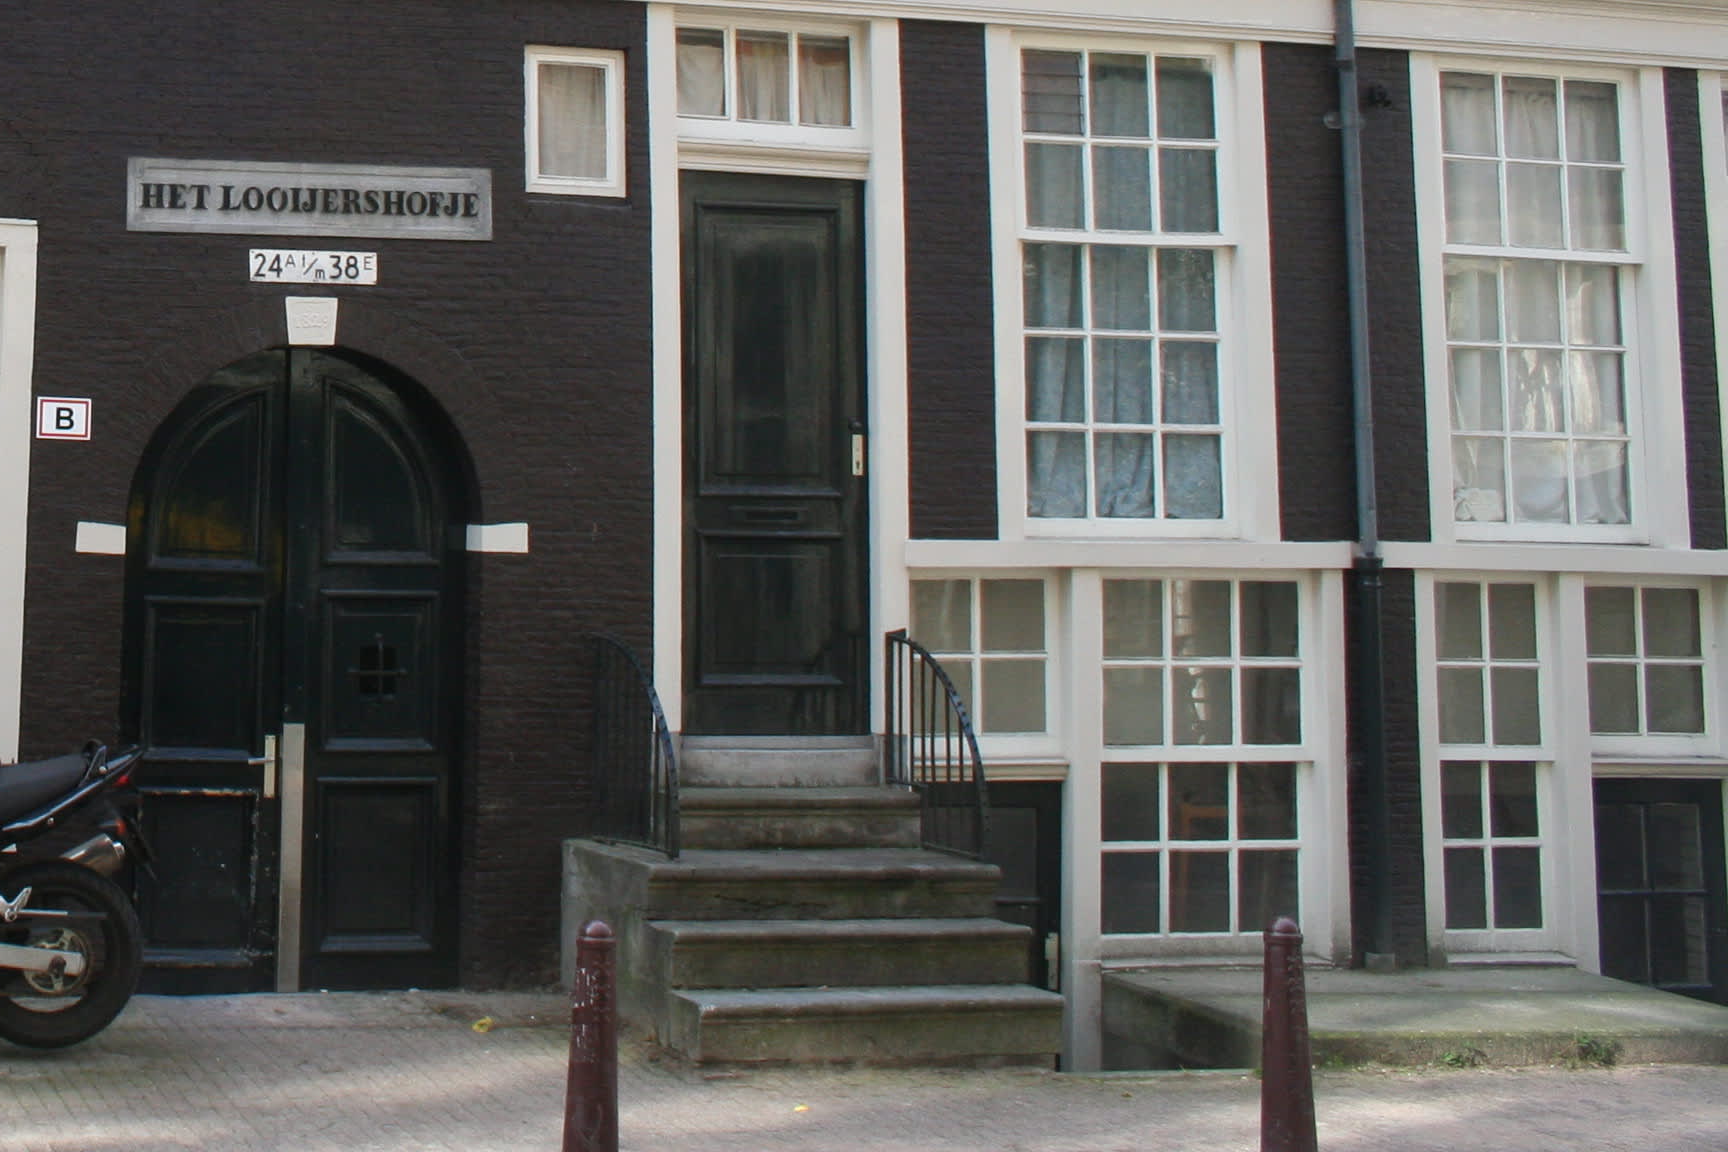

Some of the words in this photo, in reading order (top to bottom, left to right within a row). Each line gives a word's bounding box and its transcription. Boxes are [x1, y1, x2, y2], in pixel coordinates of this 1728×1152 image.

[139, 182, 210, 210] HET
[218, 184, 479, 218] LOOIJERSHOFJE
[55, 406, 74, 430] B
